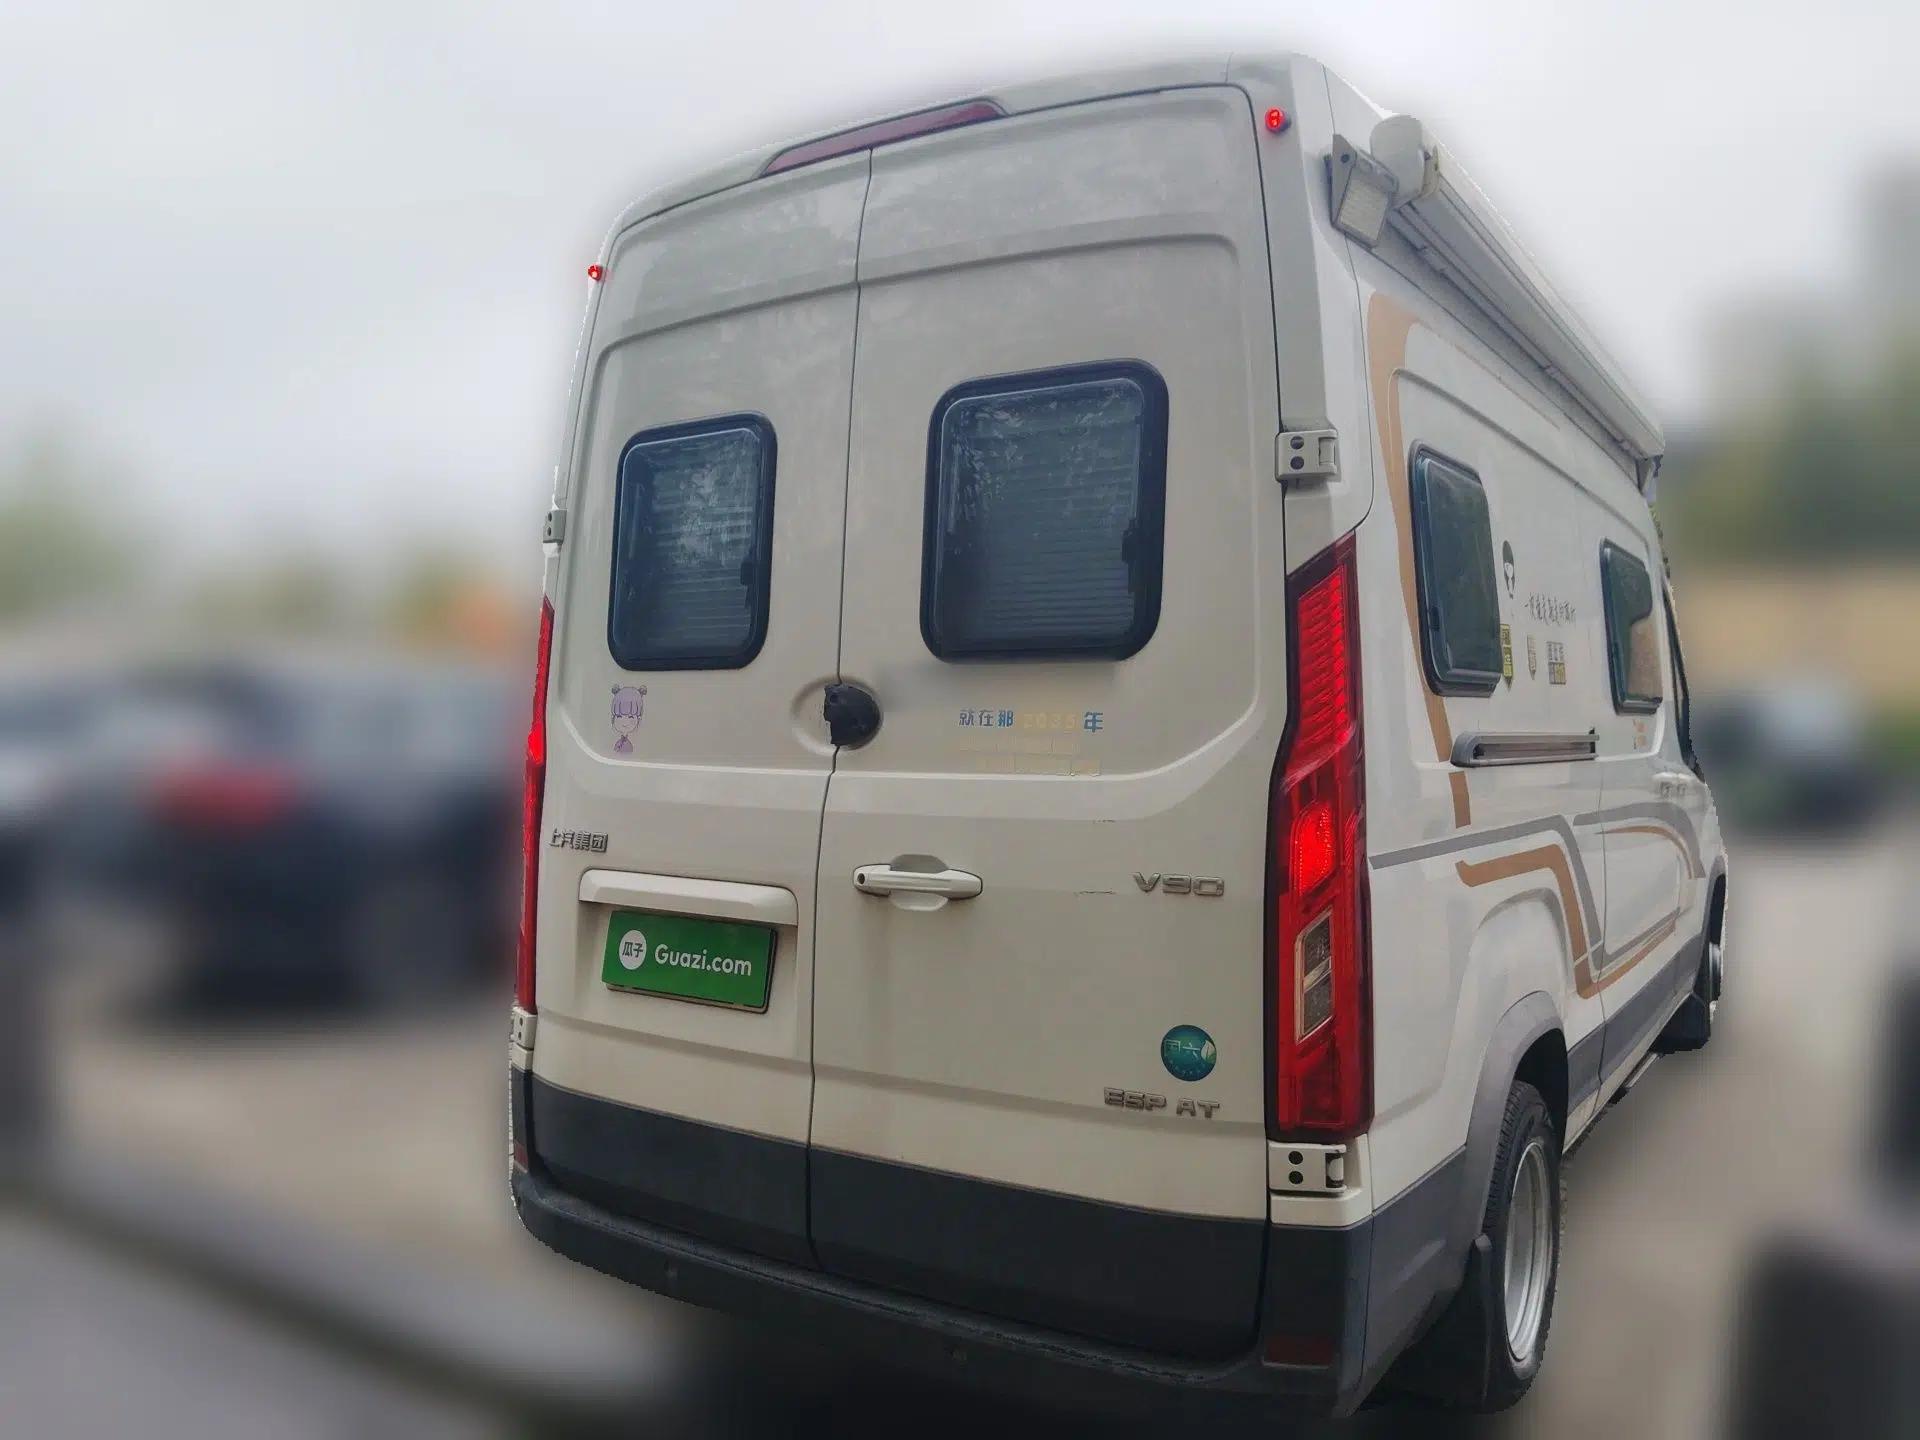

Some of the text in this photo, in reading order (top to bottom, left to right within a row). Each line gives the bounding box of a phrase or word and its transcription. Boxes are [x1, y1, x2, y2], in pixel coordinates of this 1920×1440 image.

[550, 828, 608, 853] 上汽集团
[1133, 872, 1225, 897] V90
[1104, 1087, 1220, 1119] ESP AT
